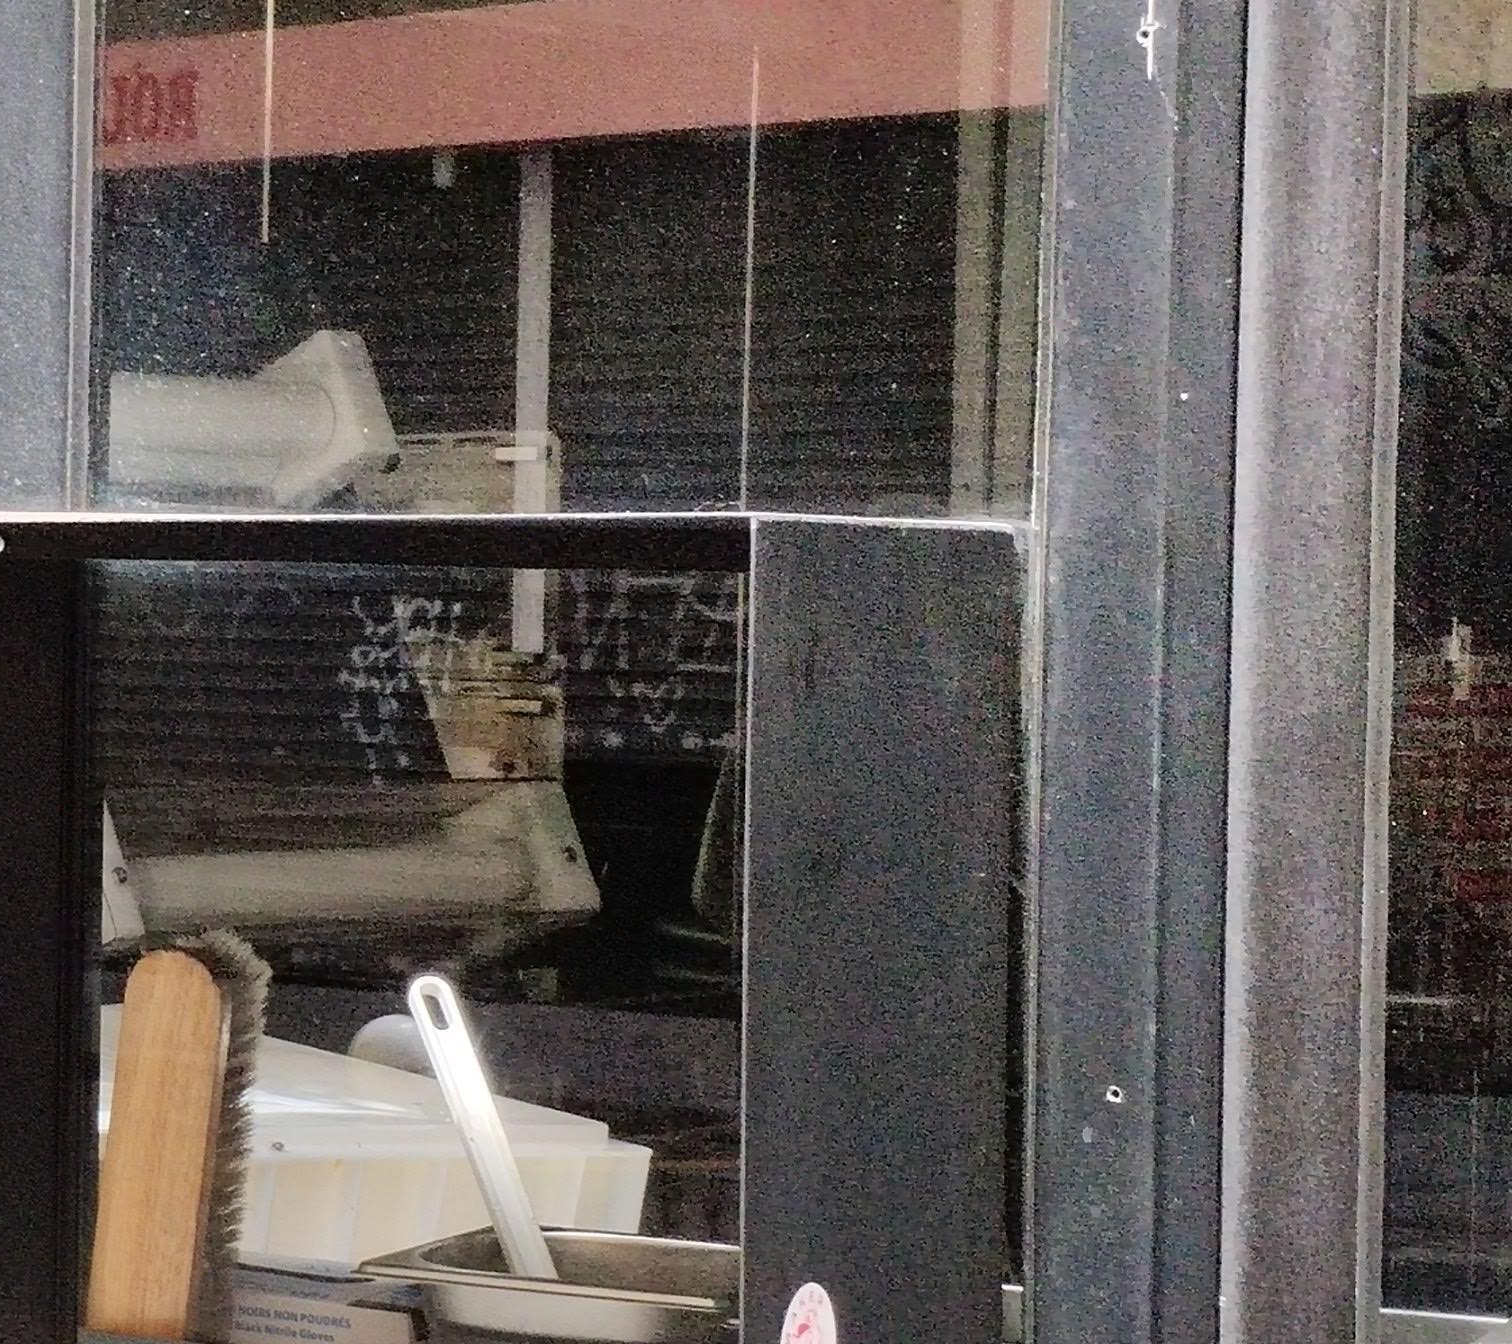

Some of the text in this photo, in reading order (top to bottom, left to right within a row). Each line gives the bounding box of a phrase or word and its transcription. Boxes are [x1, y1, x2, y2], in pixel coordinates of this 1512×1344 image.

[273, 1309, 299, 1323] NON
[300, 1312, 352, 1330] POUDRÉS
[299, 1327, 336, 1343] Gloves
